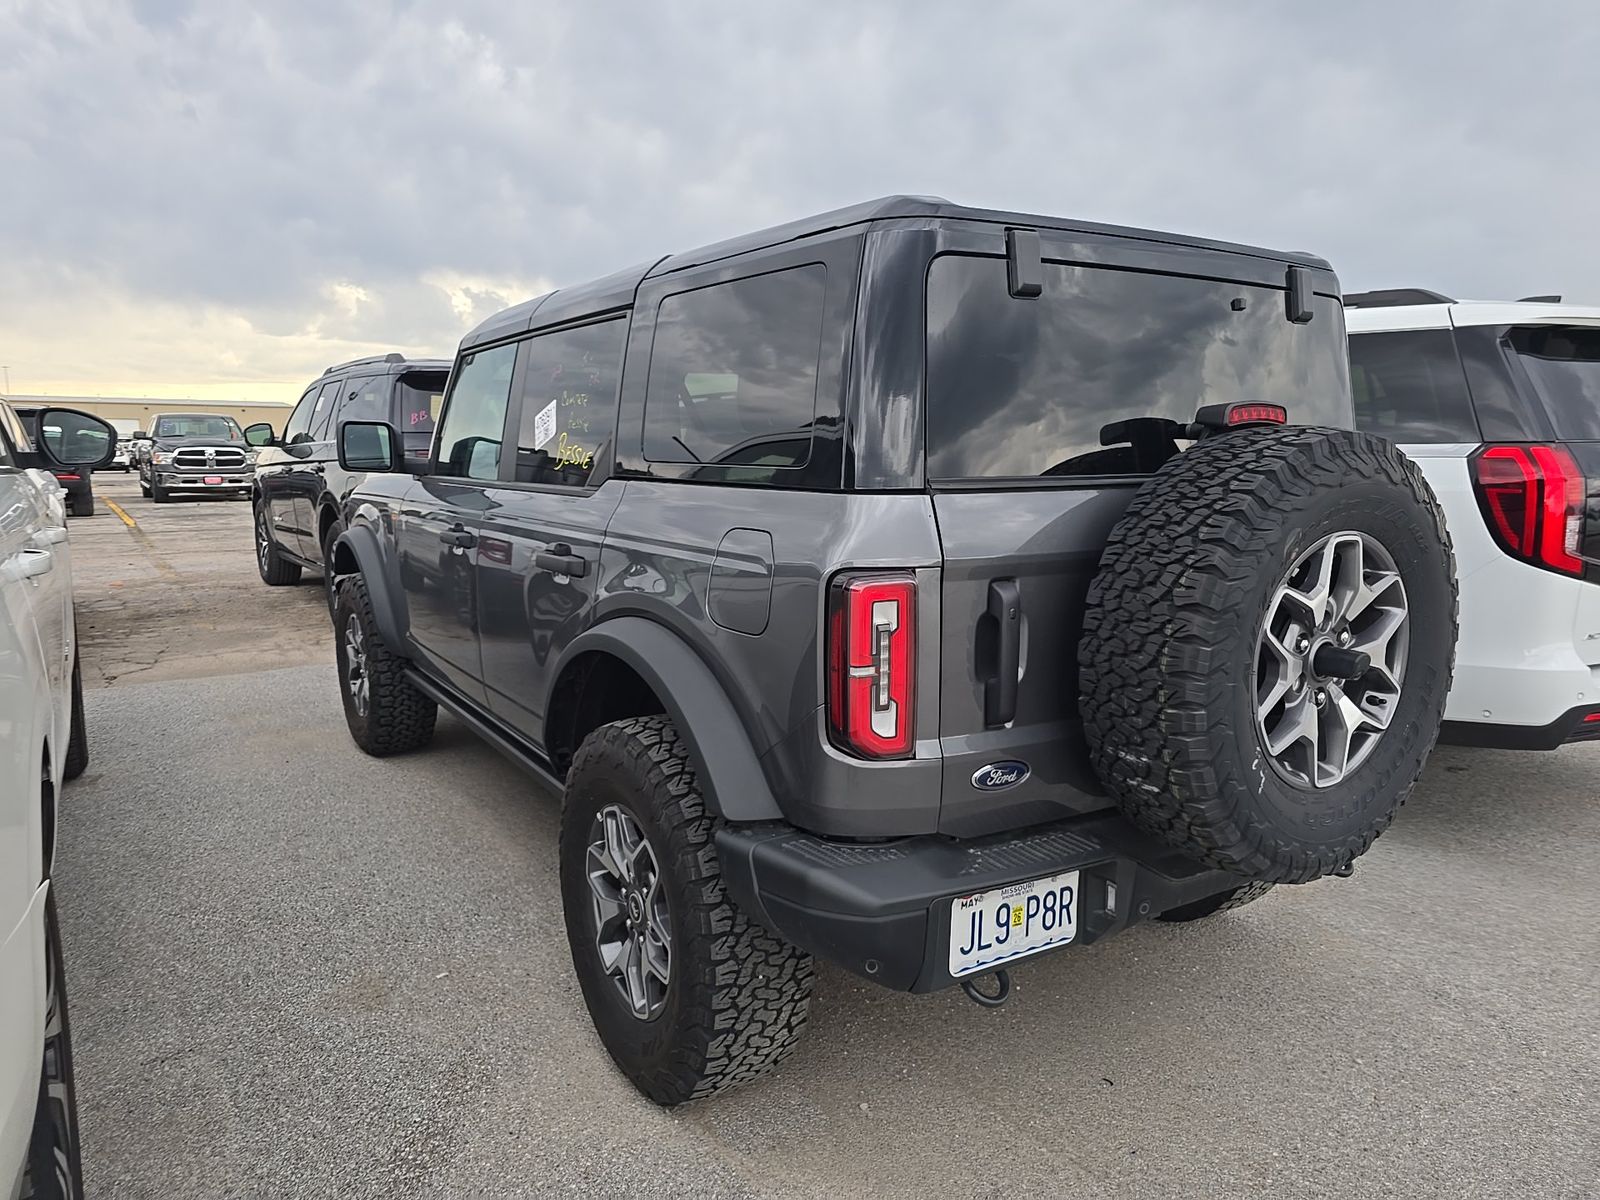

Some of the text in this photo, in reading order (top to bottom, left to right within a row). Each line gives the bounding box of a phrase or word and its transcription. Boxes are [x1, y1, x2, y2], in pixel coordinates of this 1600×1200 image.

[553, 432, 593, 471] BESSIE
[986, 768, 1018, 786] Ford
[1000, 882, 1035, 897] MISSOURI
[960, 897, 979, 910] MAY
